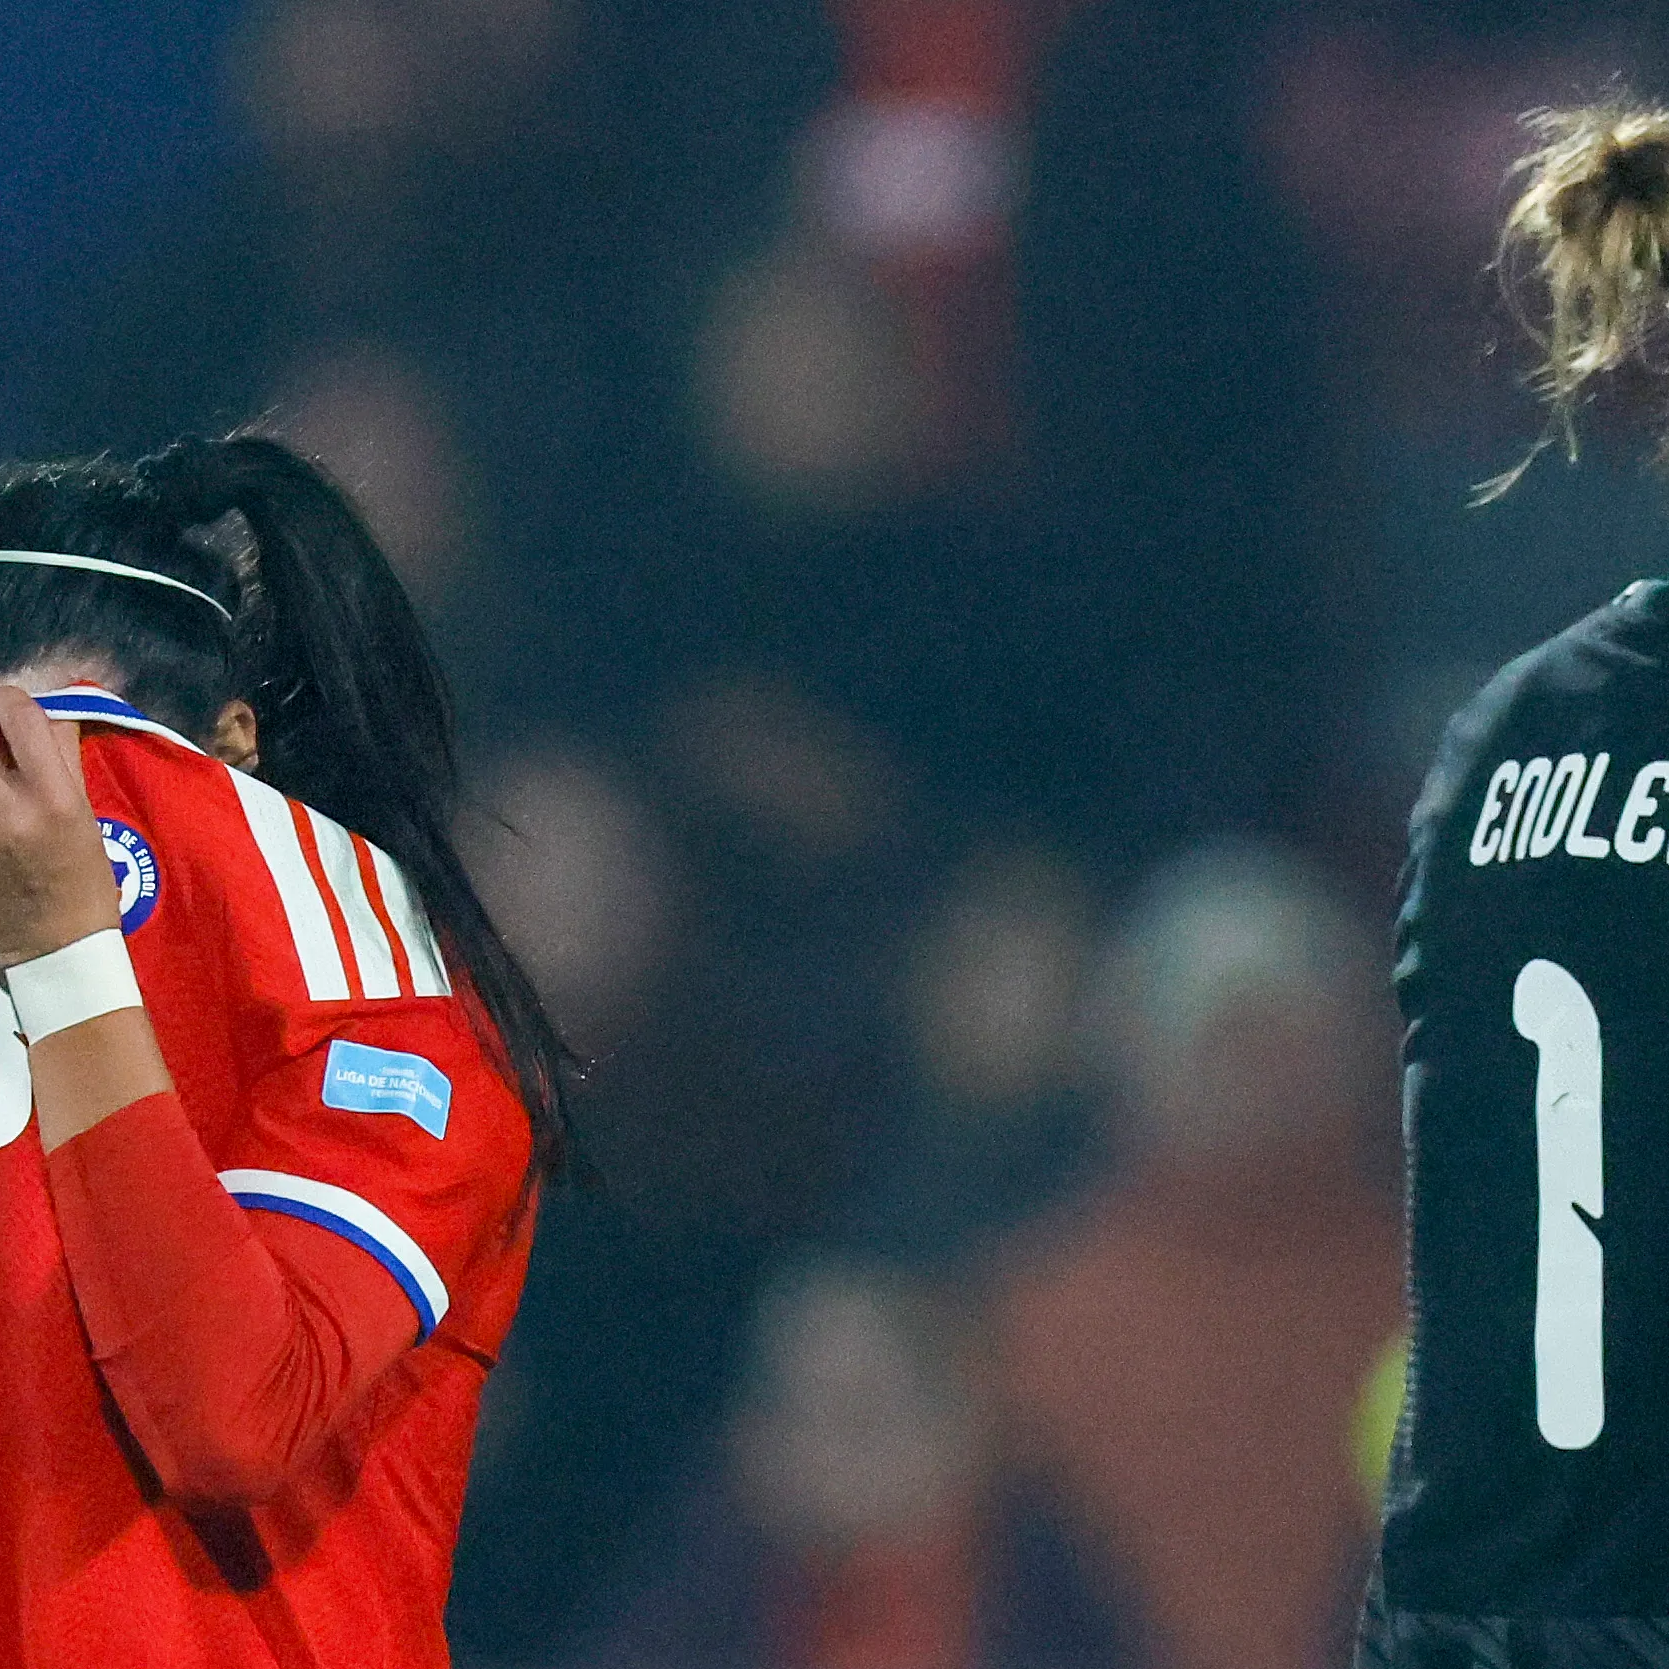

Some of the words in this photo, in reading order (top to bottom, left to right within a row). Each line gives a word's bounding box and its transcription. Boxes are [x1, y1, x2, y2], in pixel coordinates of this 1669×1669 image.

[118, 830, 138, 849] DE
[135, 848, 156, 898] FUTBOL
[335, 1069, 366, 1085] LIGA
[368, 1075, 386, 1088] DE
[1512, 957, 1606, 1451] 1
